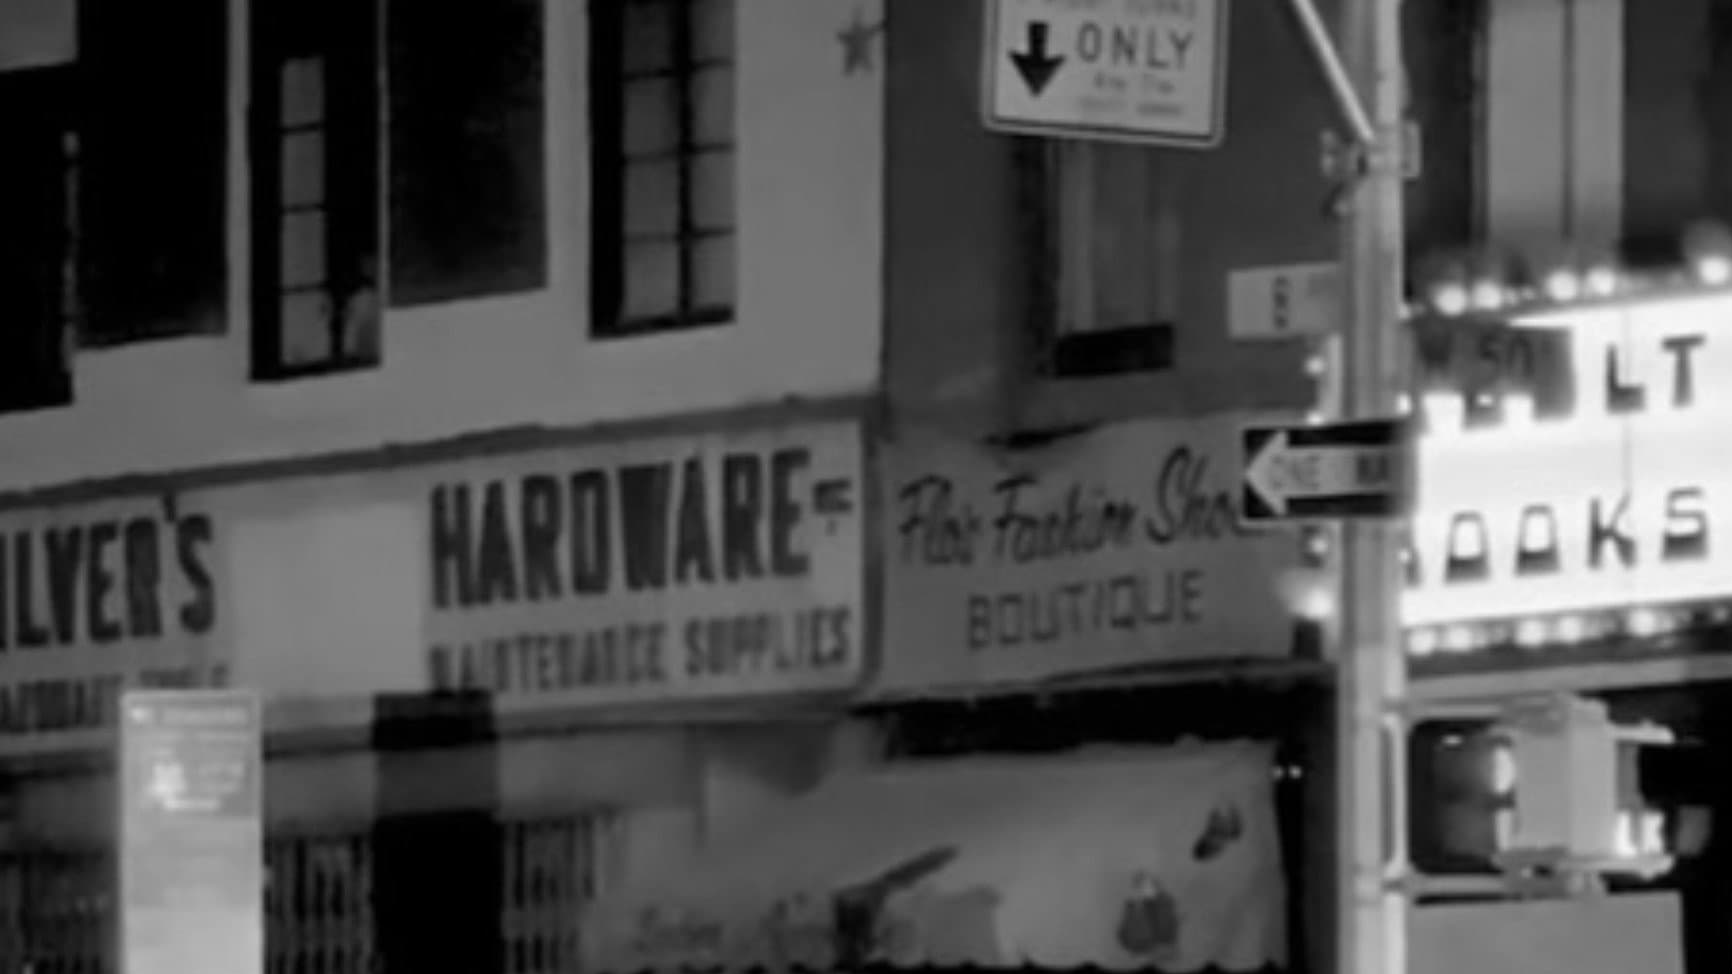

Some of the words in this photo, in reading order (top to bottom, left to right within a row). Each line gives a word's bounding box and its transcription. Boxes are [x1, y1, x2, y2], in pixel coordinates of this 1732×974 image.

[1077, 19, 1194, 71] ONLY
[430, 447, 811, 609] HARDWARE
[1402, 487, 1709, 589] OOKS
[684, 606, 850, 677] SUPPLIES
[967, 569, 1204, 650] BOUTIQUE
